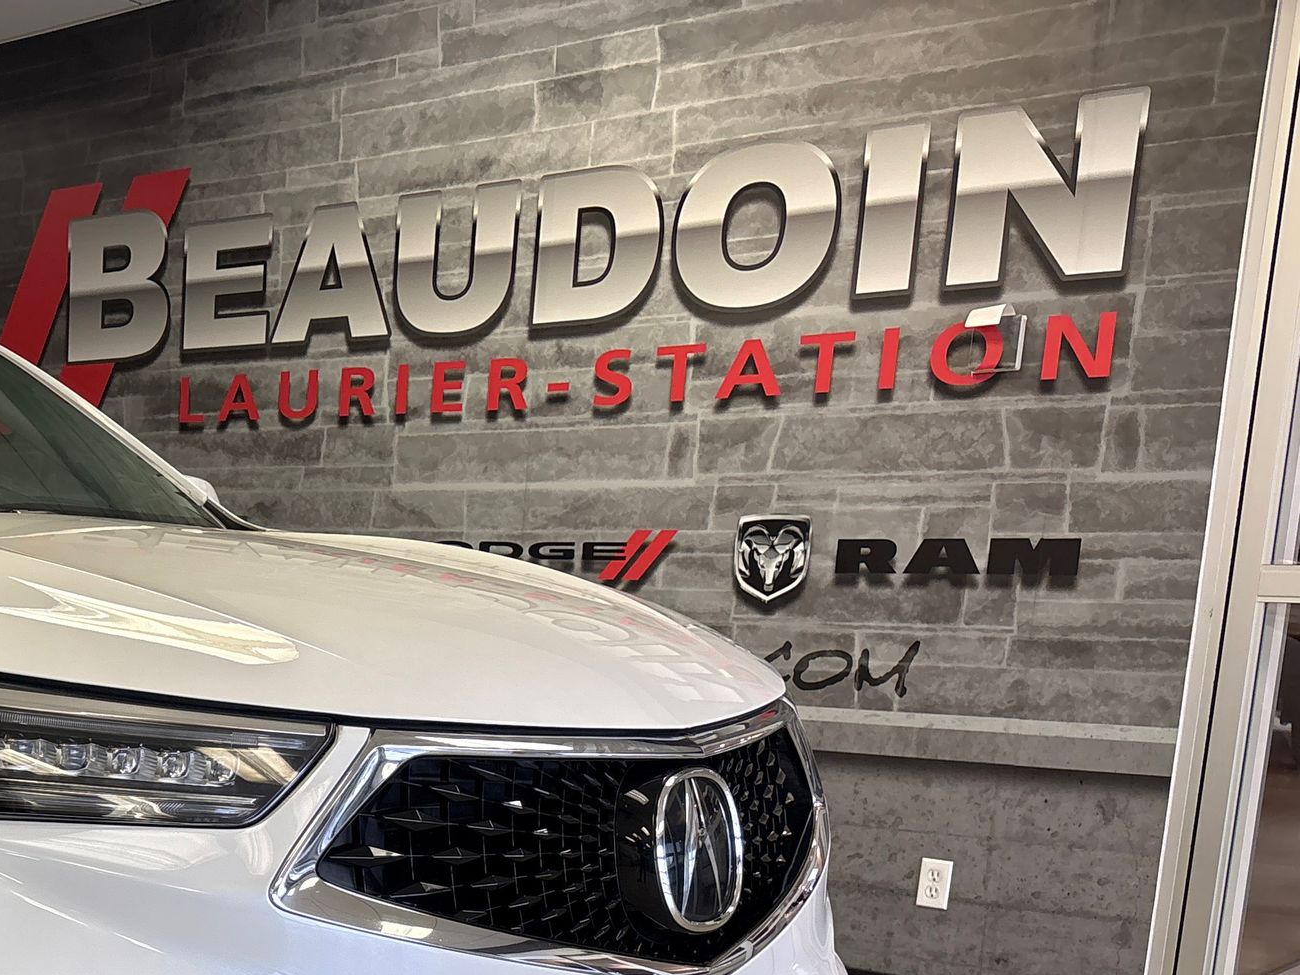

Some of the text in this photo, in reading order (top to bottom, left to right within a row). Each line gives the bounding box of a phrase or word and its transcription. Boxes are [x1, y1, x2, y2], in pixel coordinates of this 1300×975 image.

[67, 86, 1151, 364] BEAUDOIN
[178, 311, 1117, 424] LAURIER-STATION
[835, 538, 1082, 576] RAM
